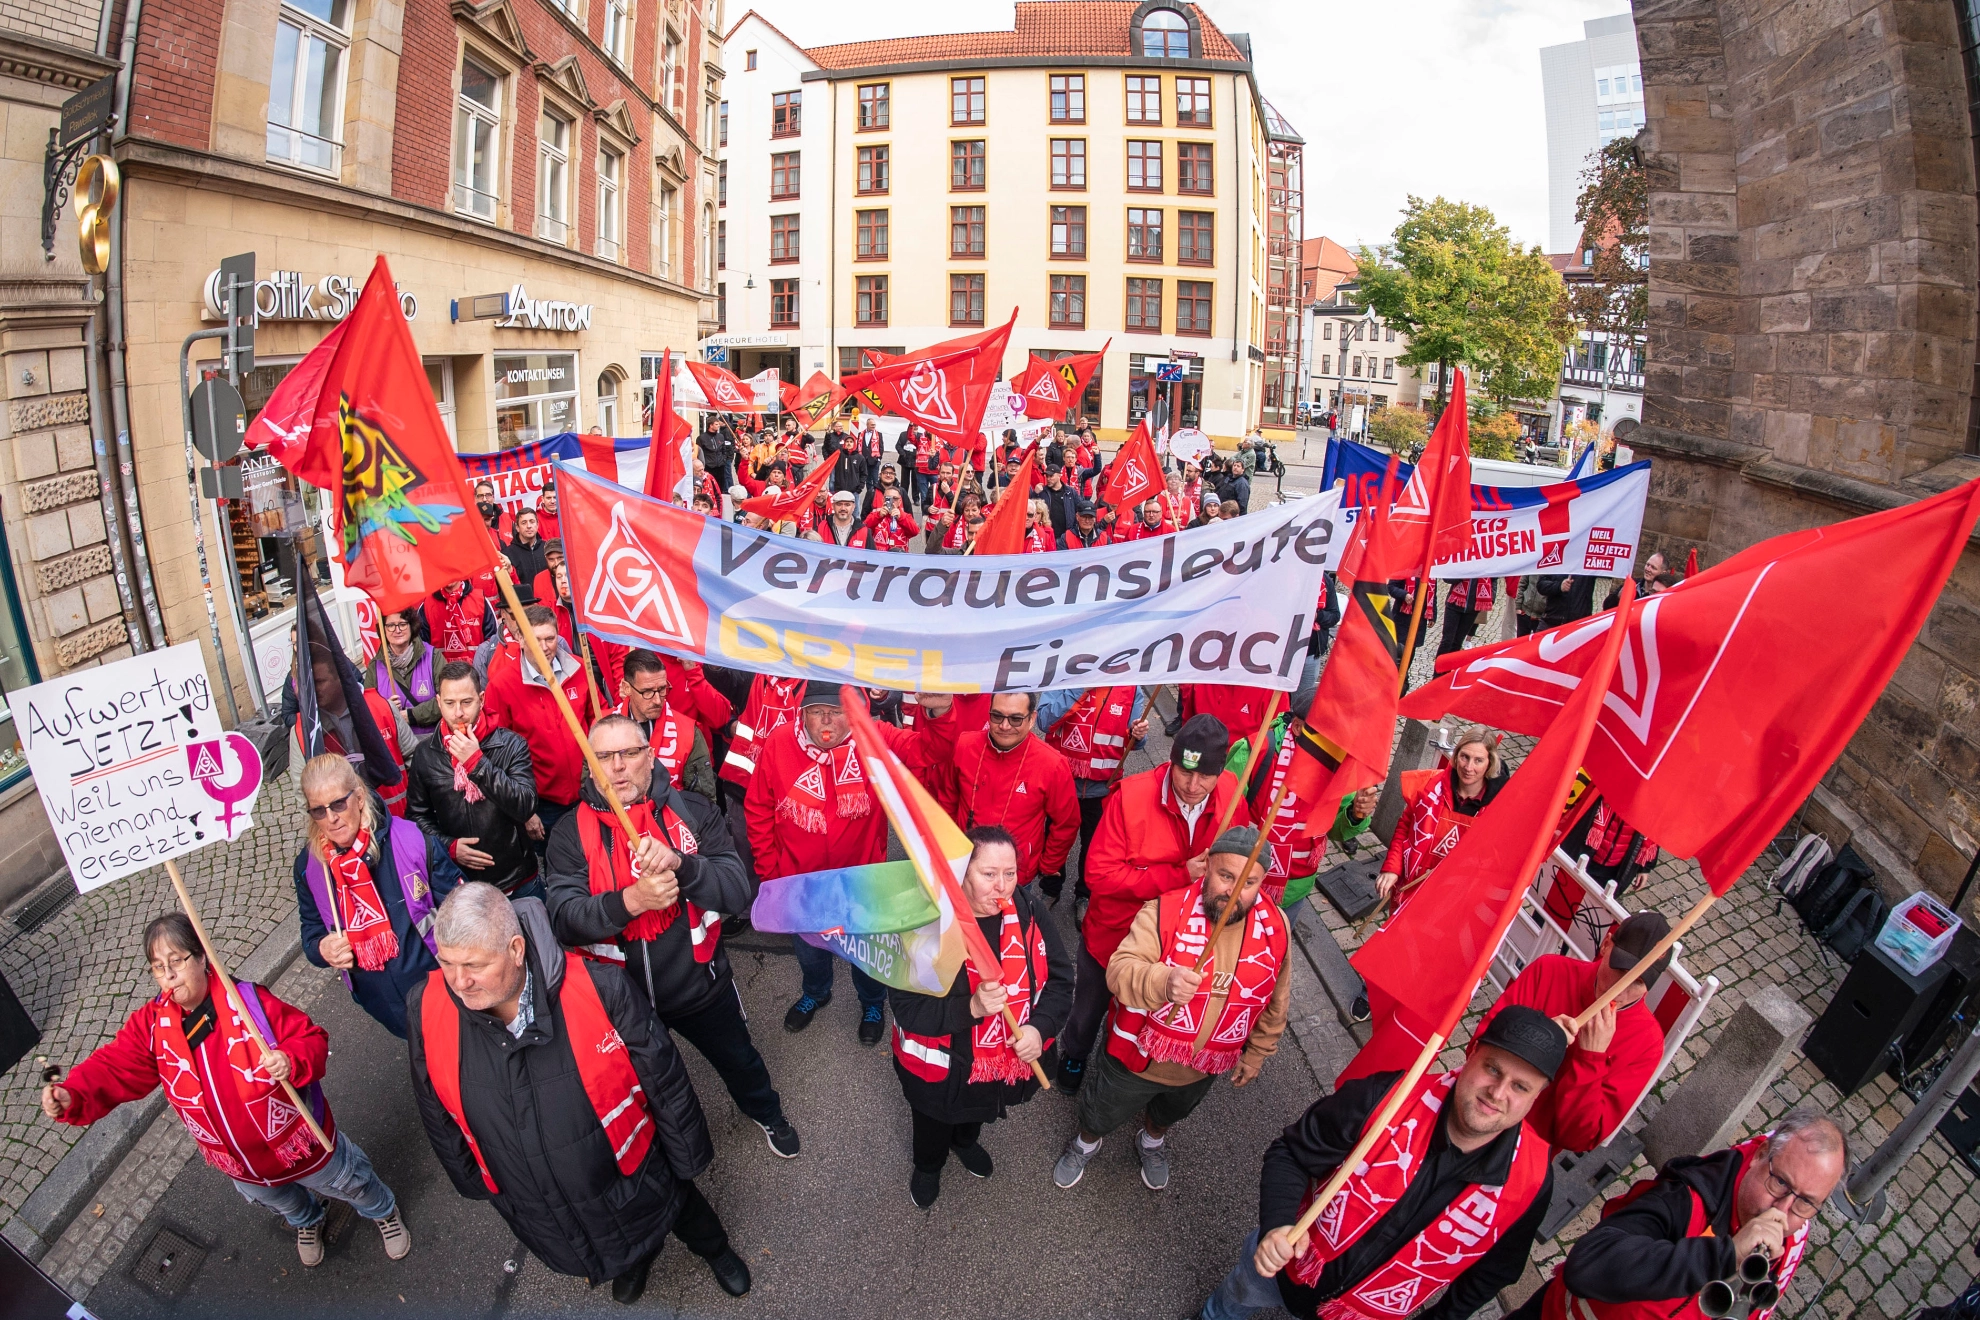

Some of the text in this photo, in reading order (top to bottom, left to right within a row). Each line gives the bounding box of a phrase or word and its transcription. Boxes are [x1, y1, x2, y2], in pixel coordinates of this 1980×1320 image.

[63, 86, 109, 119] Goldschmiede
[494, 284, 595, 331] ANTON
[710, 337, 752, 345] MERCURE
[507, 367, 565, 383] KONTAKTLINSEN
[720, 513, 1334, 608] Vertrauensleute
[1588, 544, 1630, 556] DAS JETZT
[1591, 530, 1611, 540] WEIL
[1585, 557, 1612, 569] ZÄHLT.
[718, 614, 981, 692] OPEL
[28, 668, 210, 750] Aufwertung
[62, 704, 199, 777] JETZT!
[46, 769, 184, 825] Weil uns
[65, 797, 188, 856] niemand
[79, 811, 205, 880] ersetzt!
